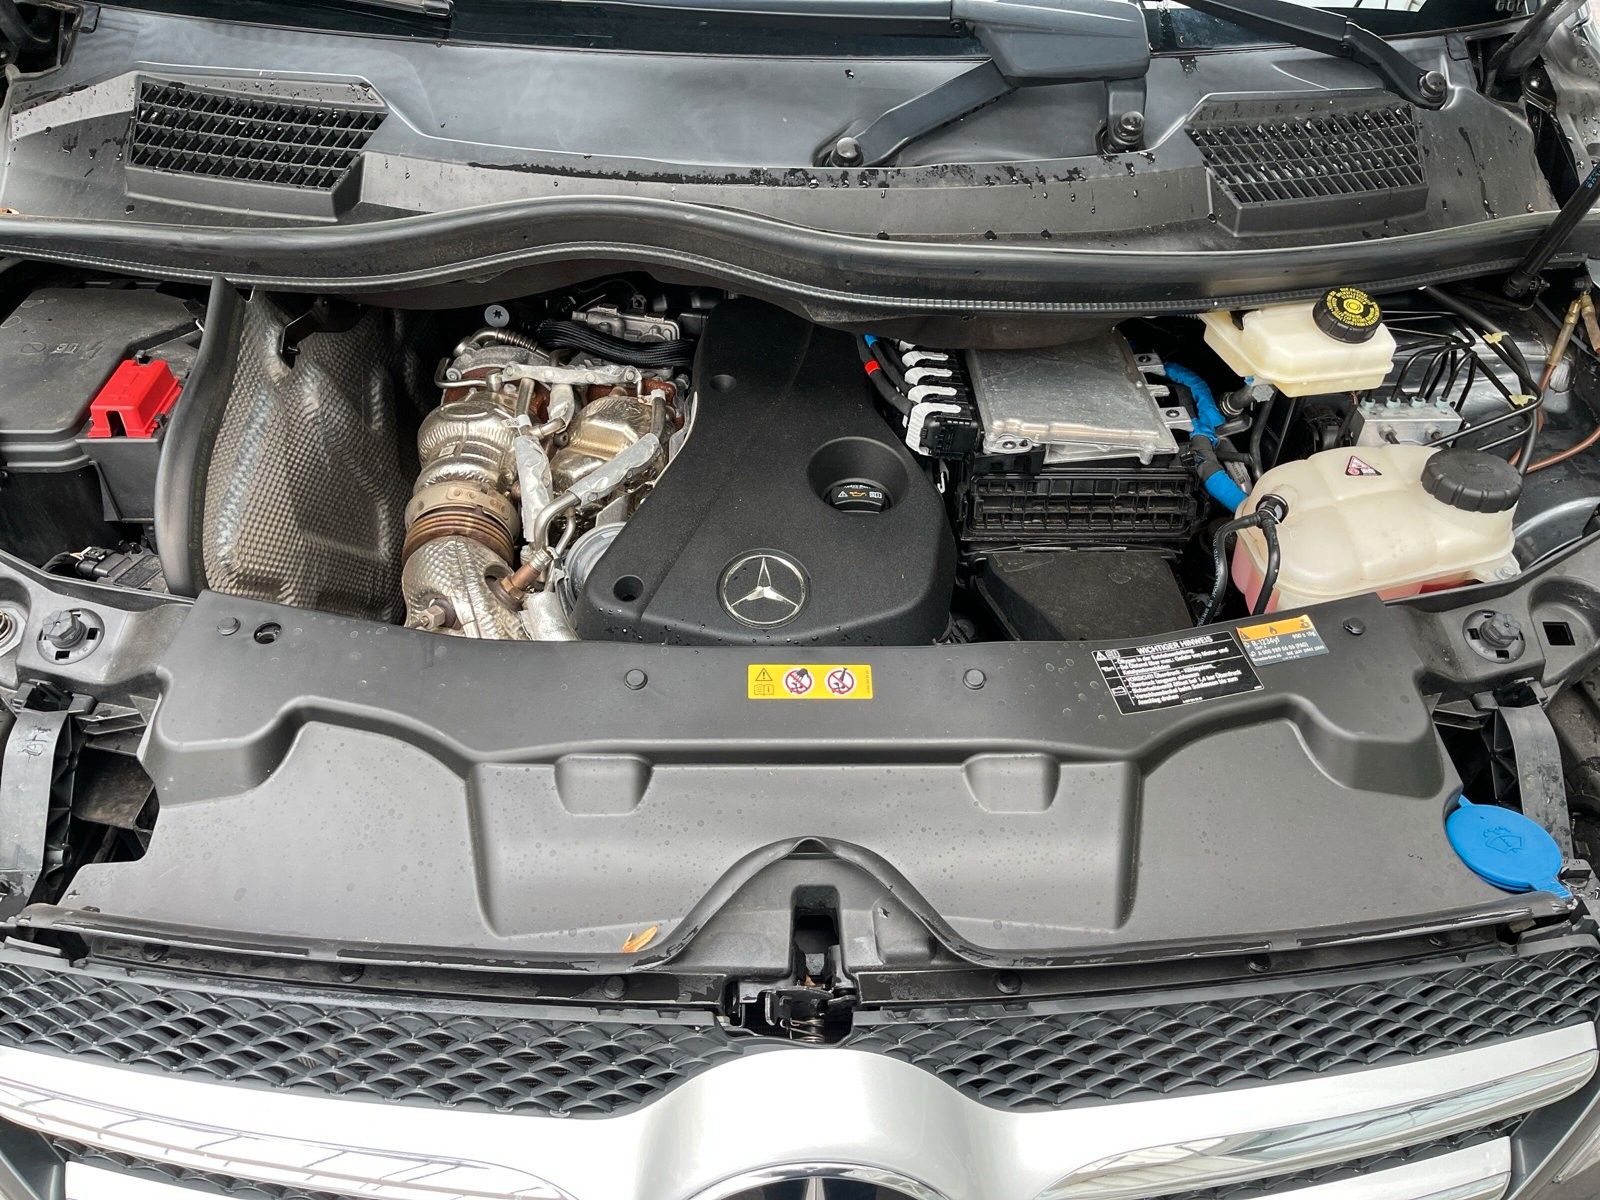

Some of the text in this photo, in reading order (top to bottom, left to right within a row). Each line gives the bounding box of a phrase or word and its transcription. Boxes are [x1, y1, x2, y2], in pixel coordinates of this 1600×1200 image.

[1136, 636, 1213, 654] WICHTIGER HINWEIS
[1251, 636, 1280, 647] R-1234yf
